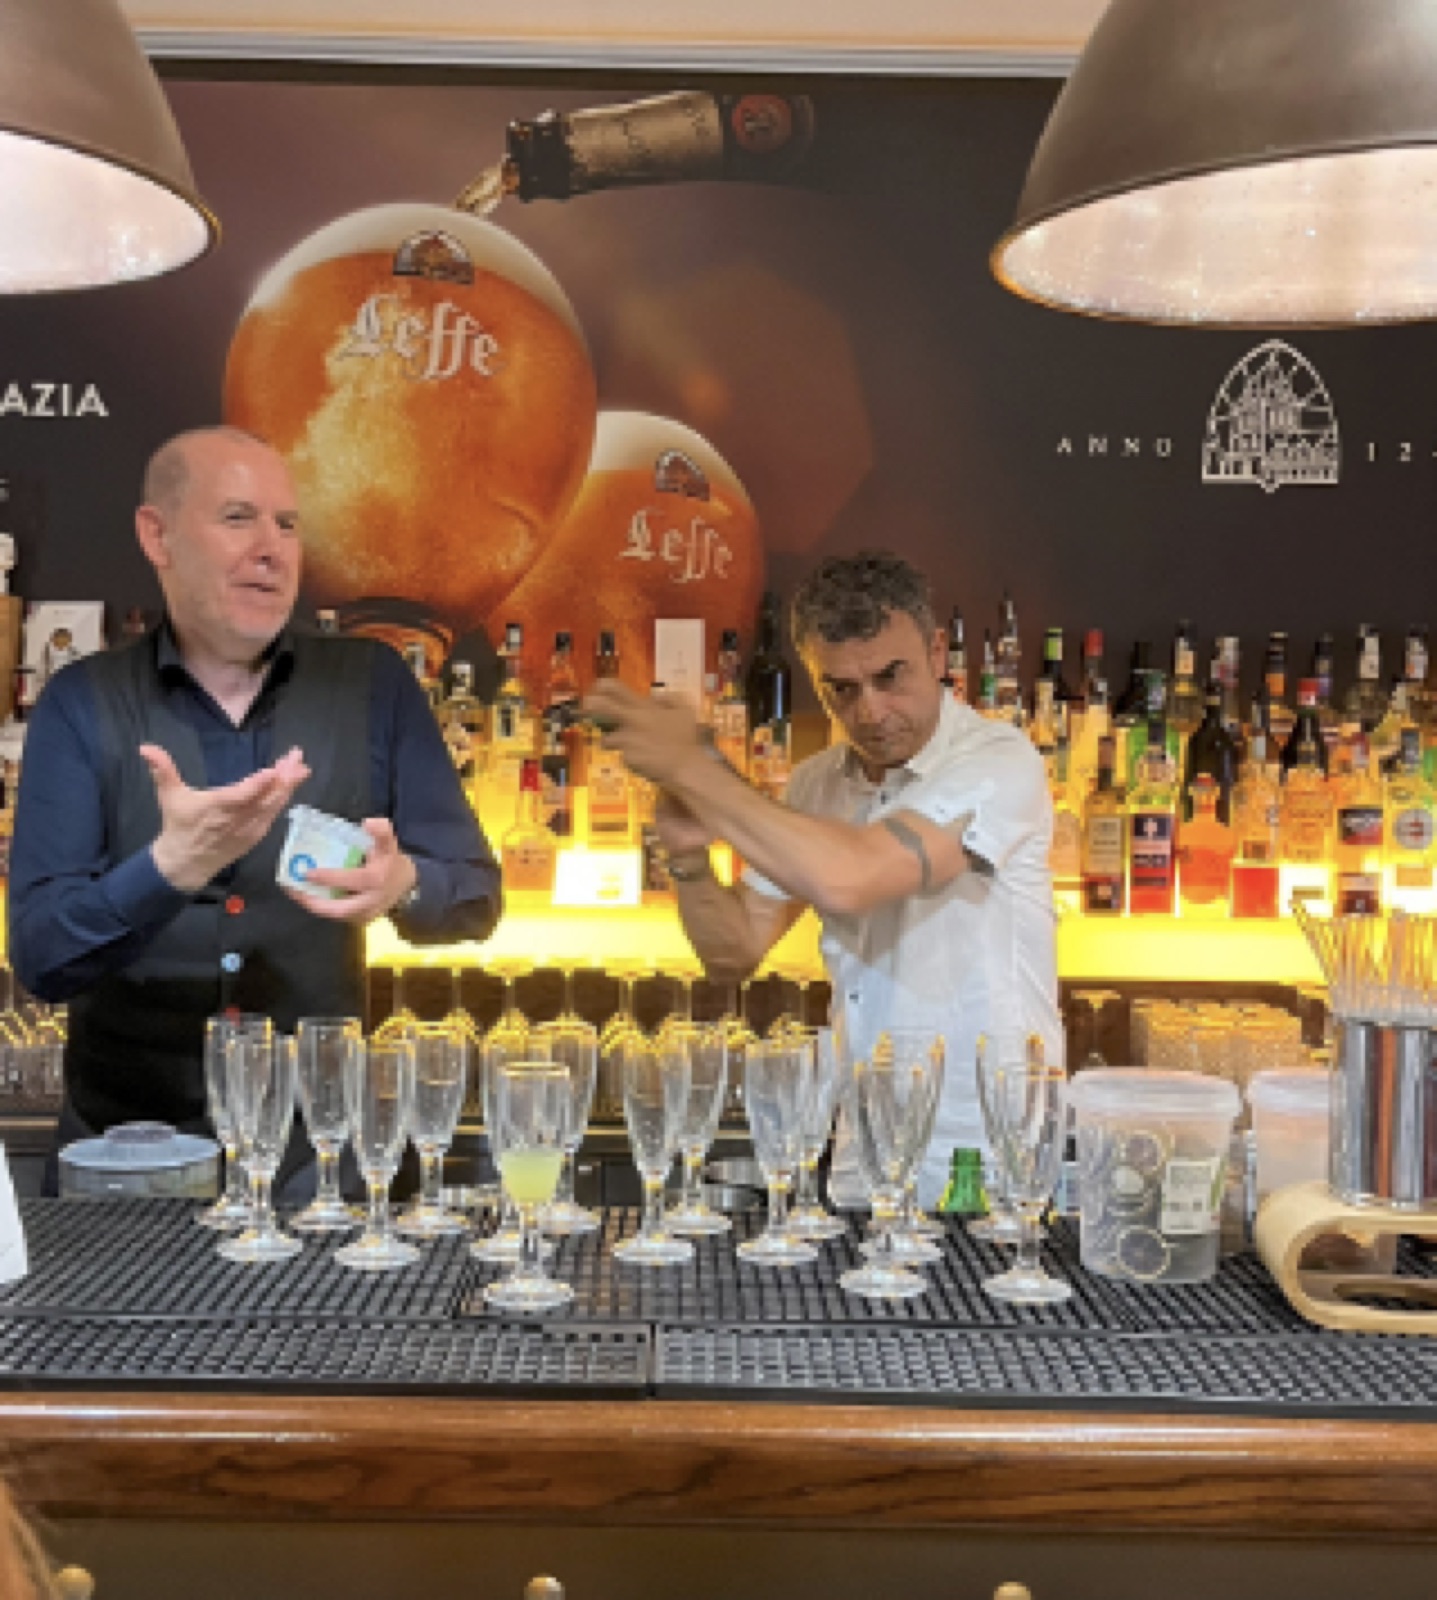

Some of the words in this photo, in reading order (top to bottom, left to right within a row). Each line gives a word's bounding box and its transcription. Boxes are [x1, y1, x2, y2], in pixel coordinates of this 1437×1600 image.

[337, 292, 503, 379] Leffe
[0, 383, 108, 417] AZIA
[1056, 438, 1173, 457] ANNO
[1366, 443, 1437, 462] 12
[618, 509, 733, 583] Leffe
